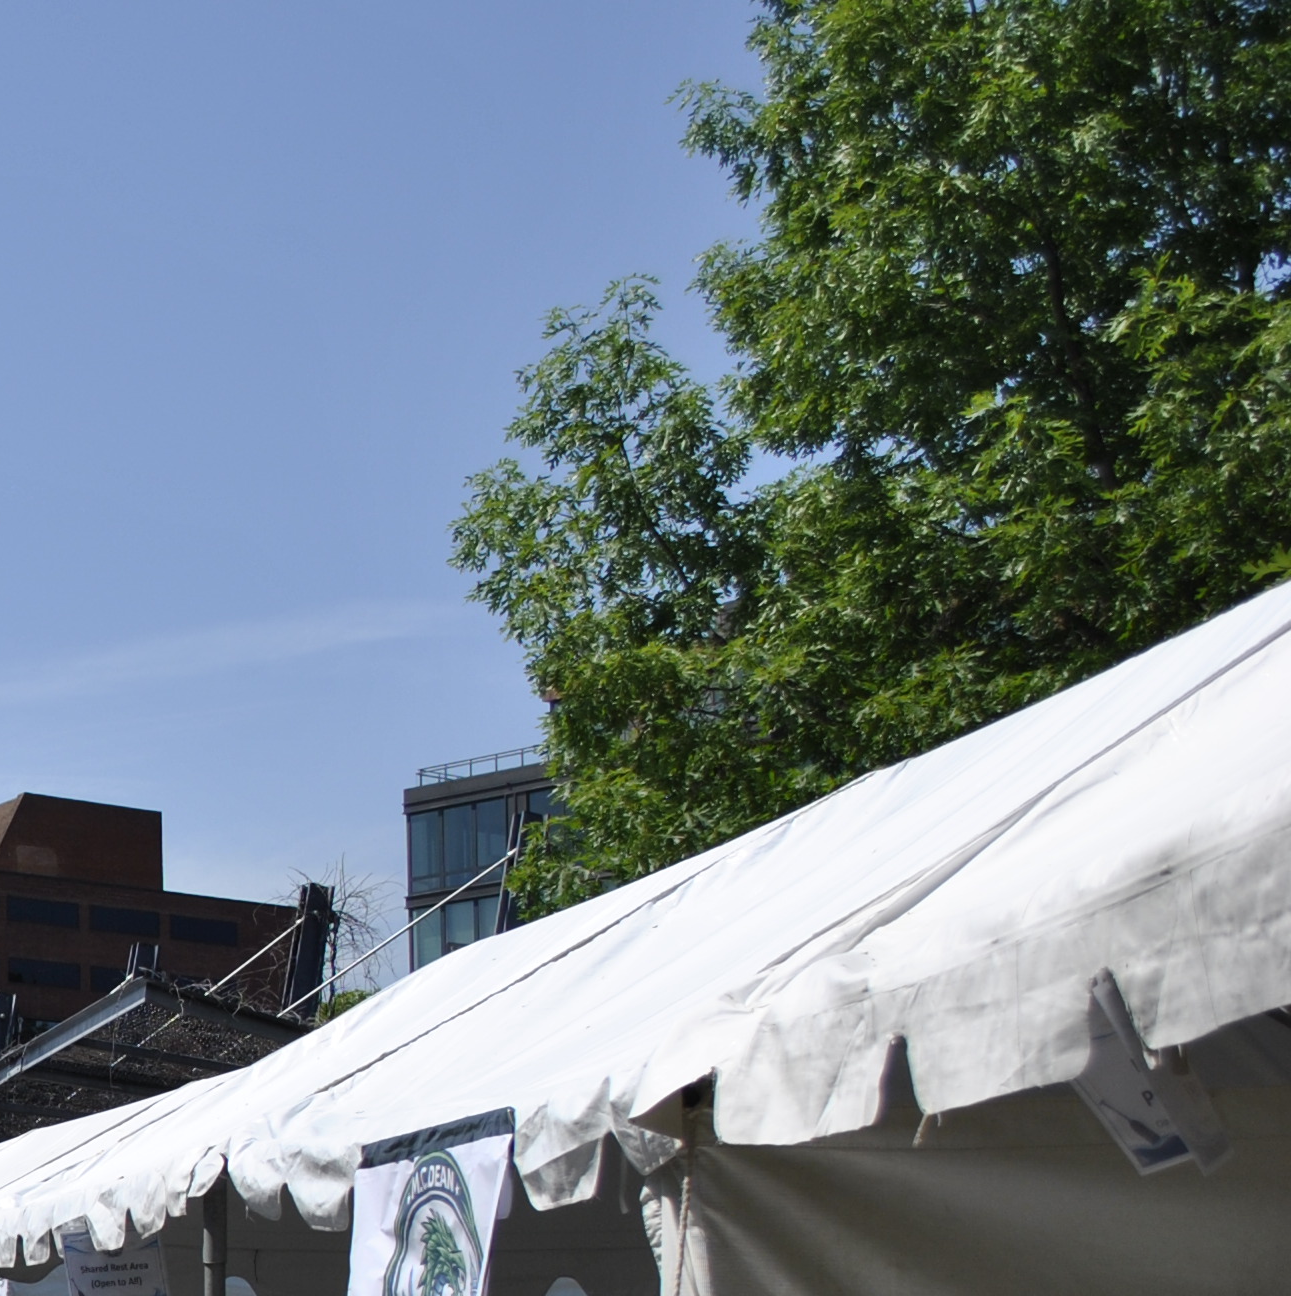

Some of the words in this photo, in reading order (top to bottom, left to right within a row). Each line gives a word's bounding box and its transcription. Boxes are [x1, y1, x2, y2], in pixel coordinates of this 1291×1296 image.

[80, 1264, 109, 1274] Shared
[110, 1263, 128, 1272] Rest
[130, 1262, 149, 1271] Area
[91, 1279, 116, 1289] (Open
[118, 1278, 126, 1286] to
[128, 1276, 143, 1287] All)
